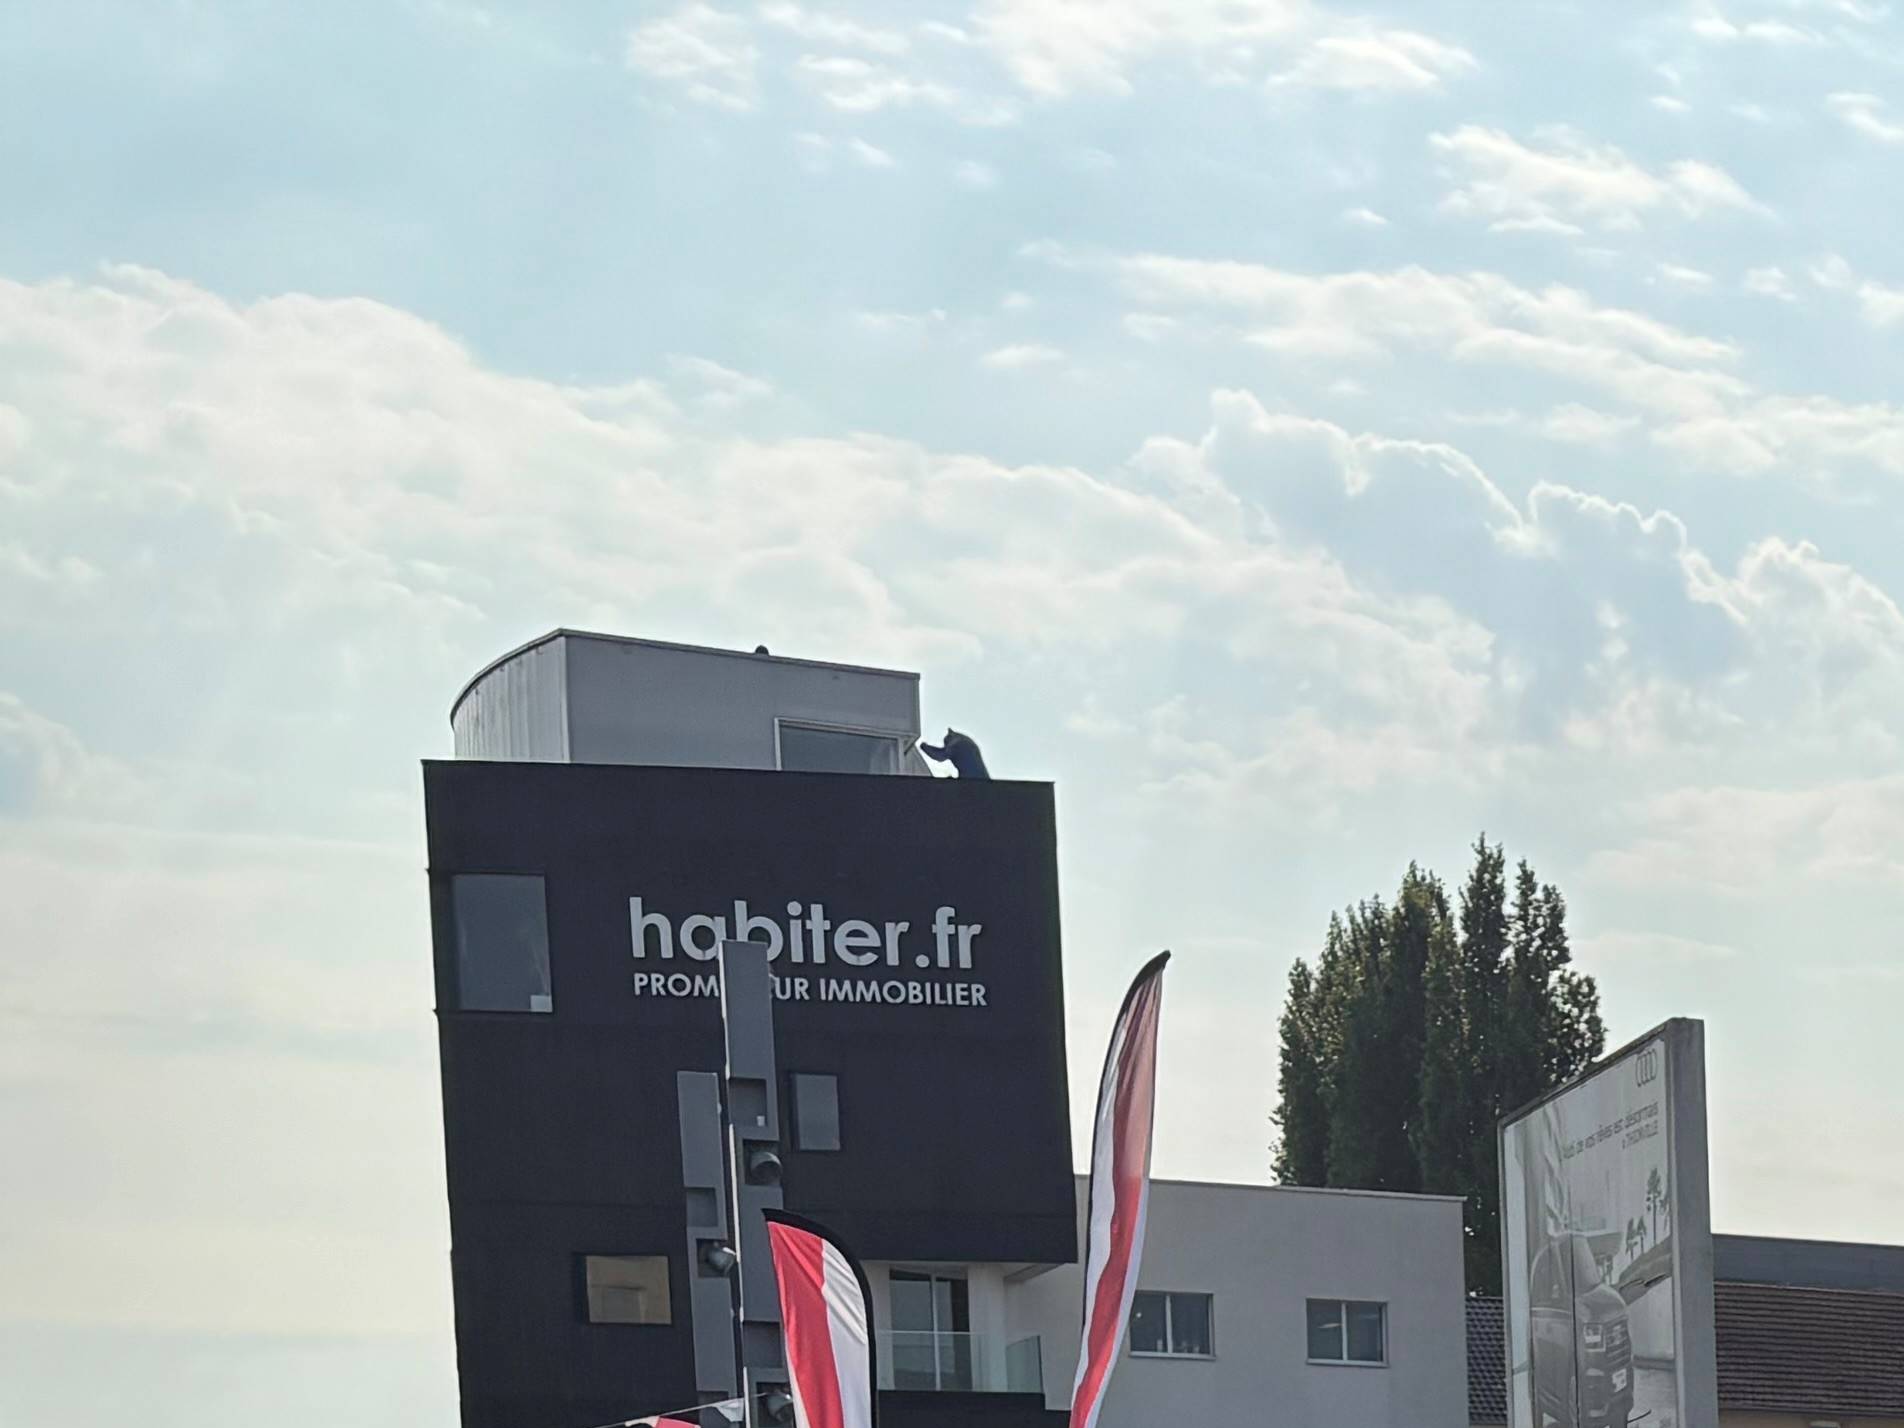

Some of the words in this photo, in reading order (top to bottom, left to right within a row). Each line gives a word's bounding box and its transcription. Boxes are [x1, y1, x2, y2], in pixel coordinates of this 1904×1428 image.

[629, 896, 983, 969] habiter.fr
[634, 972, 810, 1001] PROMUR
[819, 977, 988, 1007] IMMOBILIER
